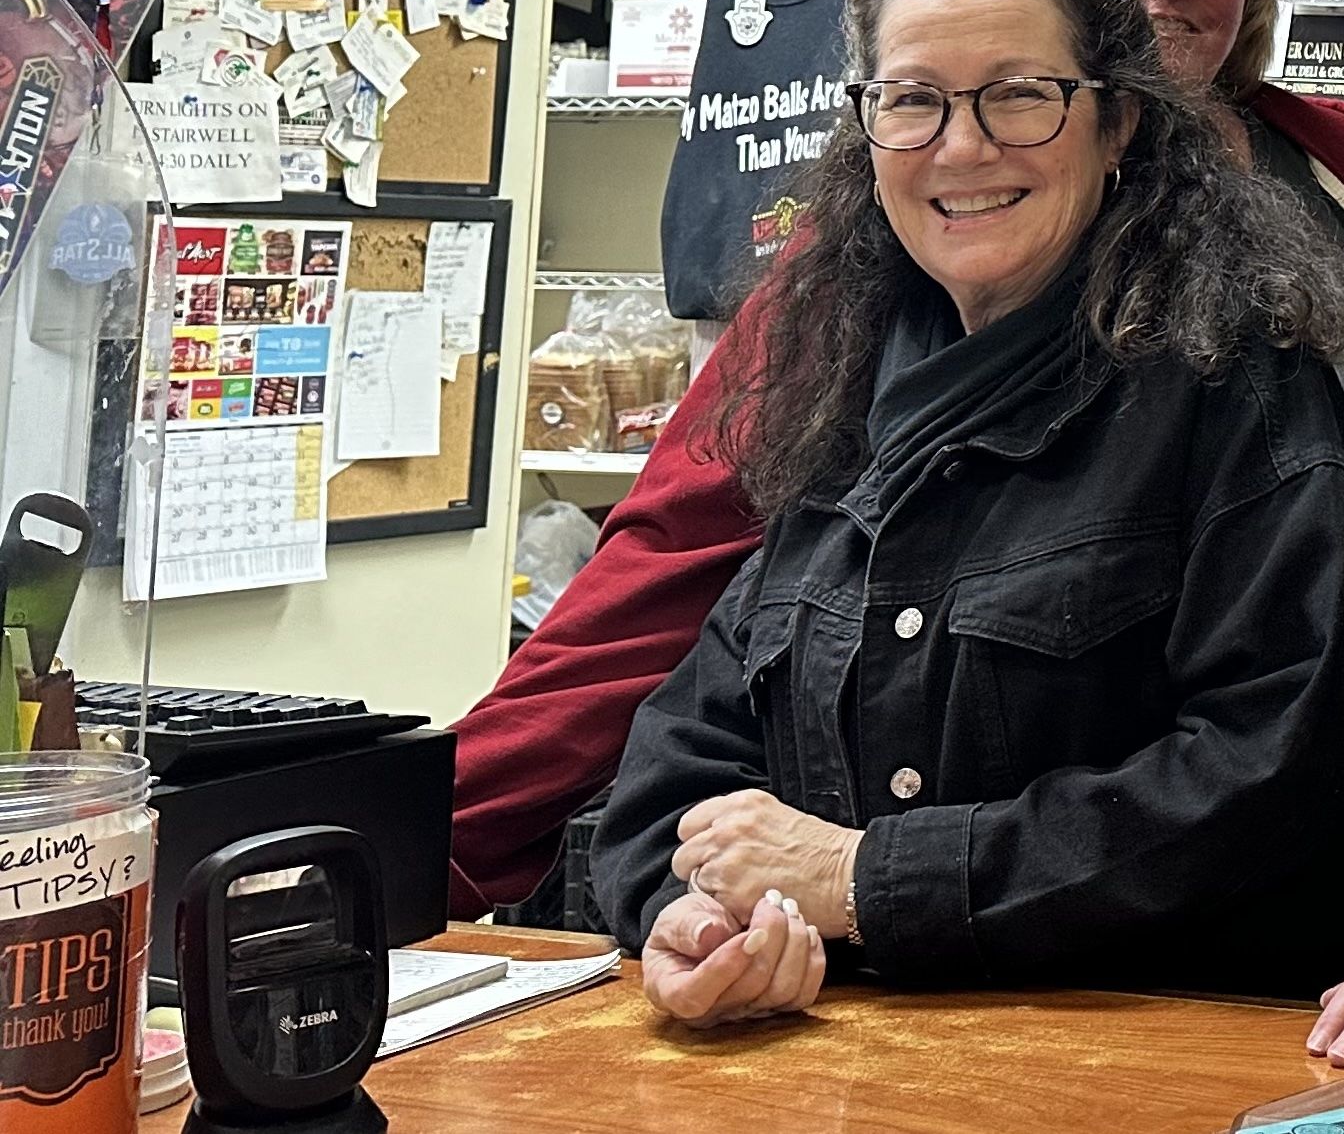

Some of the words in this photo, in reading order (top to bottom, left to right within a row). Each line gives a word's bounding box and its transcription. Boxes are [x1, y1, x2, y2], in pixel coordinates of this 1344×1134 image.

[1303, 42, 1343, 64] CAJUN
[170, 101, 232, 118] LIGHTS
[239, 103, 267, 117] ON
[700, 93, 759, 131] Matzo
[764, 81, 810, 120] Balls
[152, 127, 255, 143] STAIRWELL
[190, 153, 252, 169] DAILY
[736, 134, 781, 172] Than
[0, 854, 135, 912] TIPSY?
[4, 929, 113, 1011] TIPS
[3, 1016, 66, 1050] thank
[72, 994, 110, 1035] you!
[299, 1009, 339, 1029] ZEBRA
